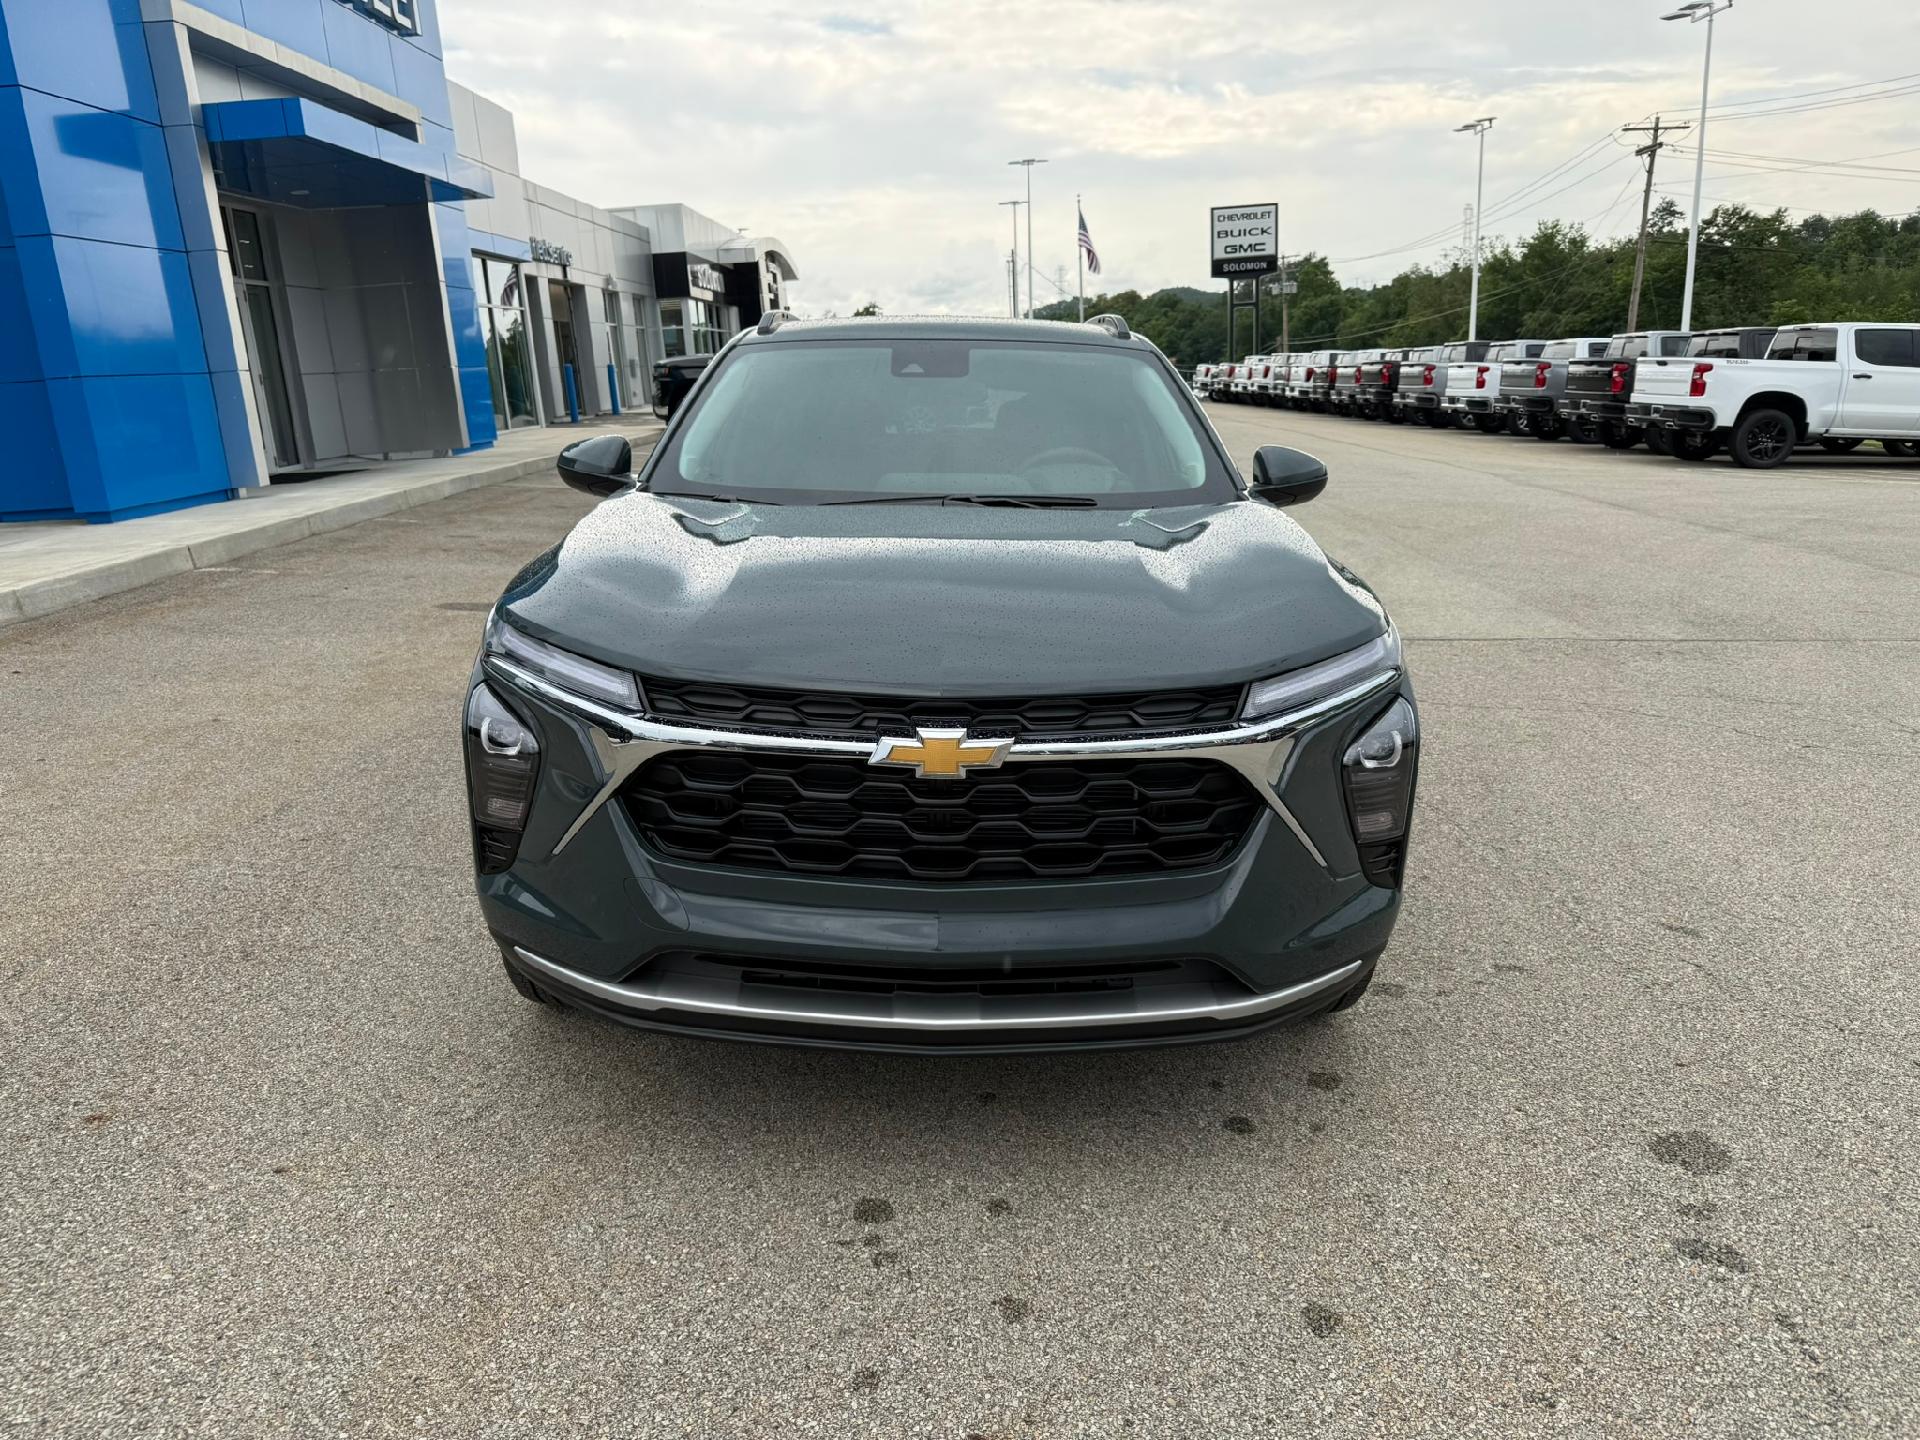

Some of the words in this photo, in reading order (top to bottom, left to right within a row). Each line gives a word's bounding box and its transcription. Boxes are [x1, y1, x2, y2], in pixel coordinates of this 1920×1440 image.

[1217, 211, 1272, 222] CHEVROLET
[1217, 226, 1272, 239] BUICK
[1224, 242, 1267, 254] GMC
[1222, 262, 1268, 272] SOLOMON
